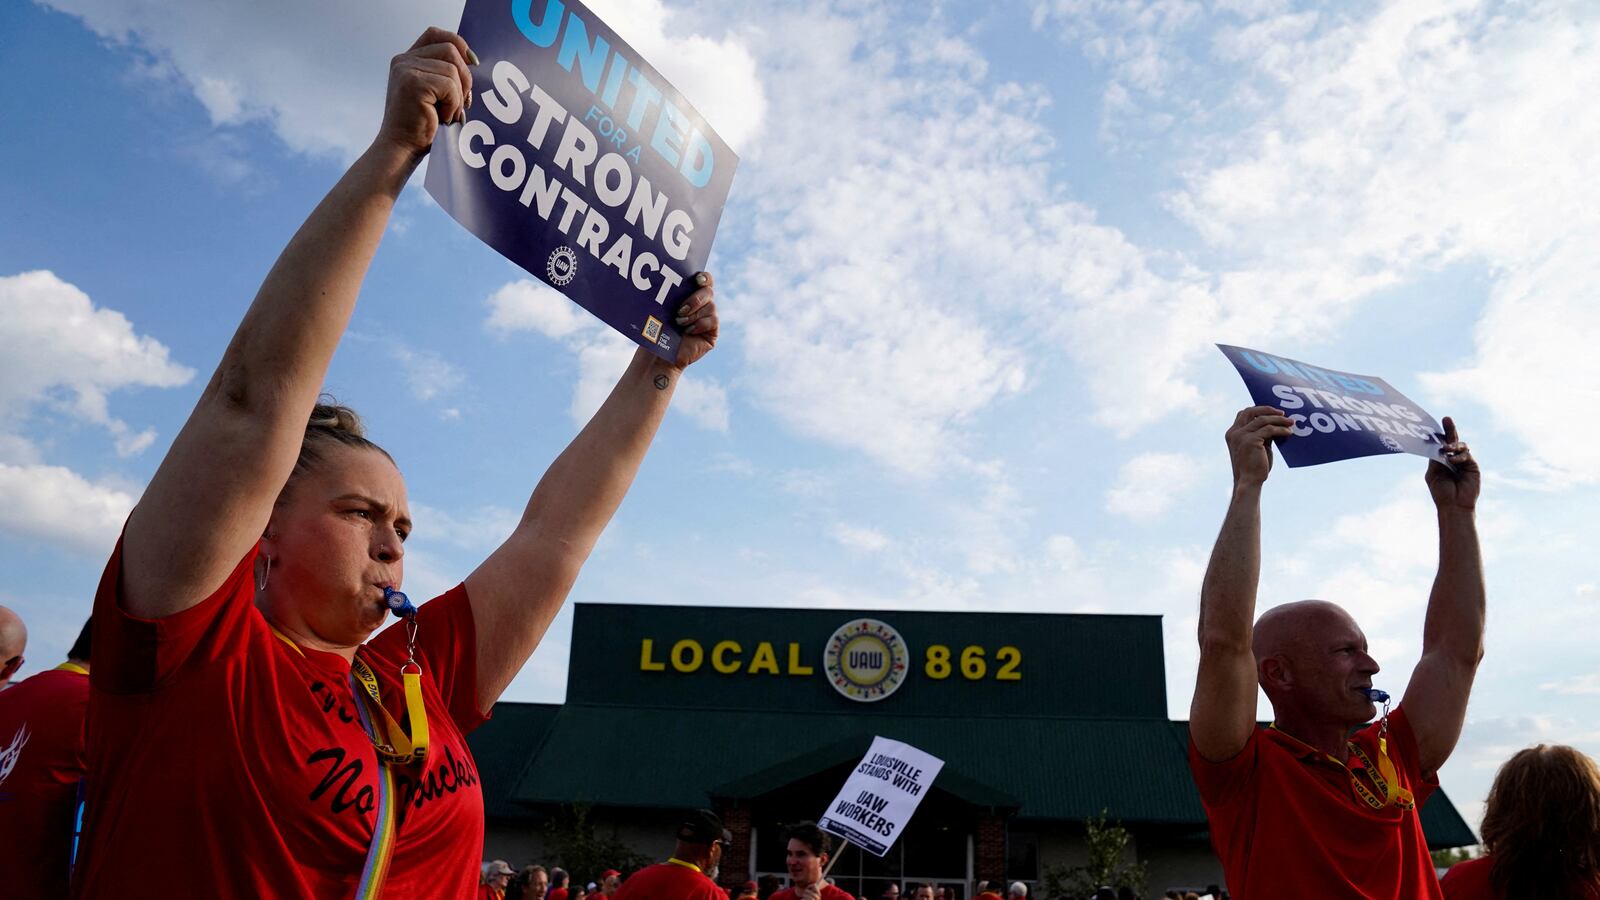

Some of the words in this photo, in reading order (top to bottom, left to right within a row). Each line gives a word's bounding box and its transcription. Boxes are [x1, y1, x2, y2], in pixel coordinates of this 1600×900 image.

[511, 0, 714, 188] UNITED
[584, 106, 627, 149] FOR
[626, 144, 641, 164] A
[481, 60, 694, 261] STRONG
[458, 120, 683, 306] CONTRACT
[1240, 351, 1385, 395] UNITED
[1272, 384, 1422, 422] STRONG
[1291, 412, 1443, 448] CONTRACT
[640, 639, 814, 675] LOCAL
[849, 650, 883, 670] UAW
[924, 645, 1022, 681] 862
[307, 747, 374, 815] No
[858, 763, 893, 781] STANDS
[892, 773, 922, 796] WITH
[870, 753, 922, 781] LOUISVILLE
[835, 800, 895, 837] WORKERS
[856, 790, 889, 813] UAW
